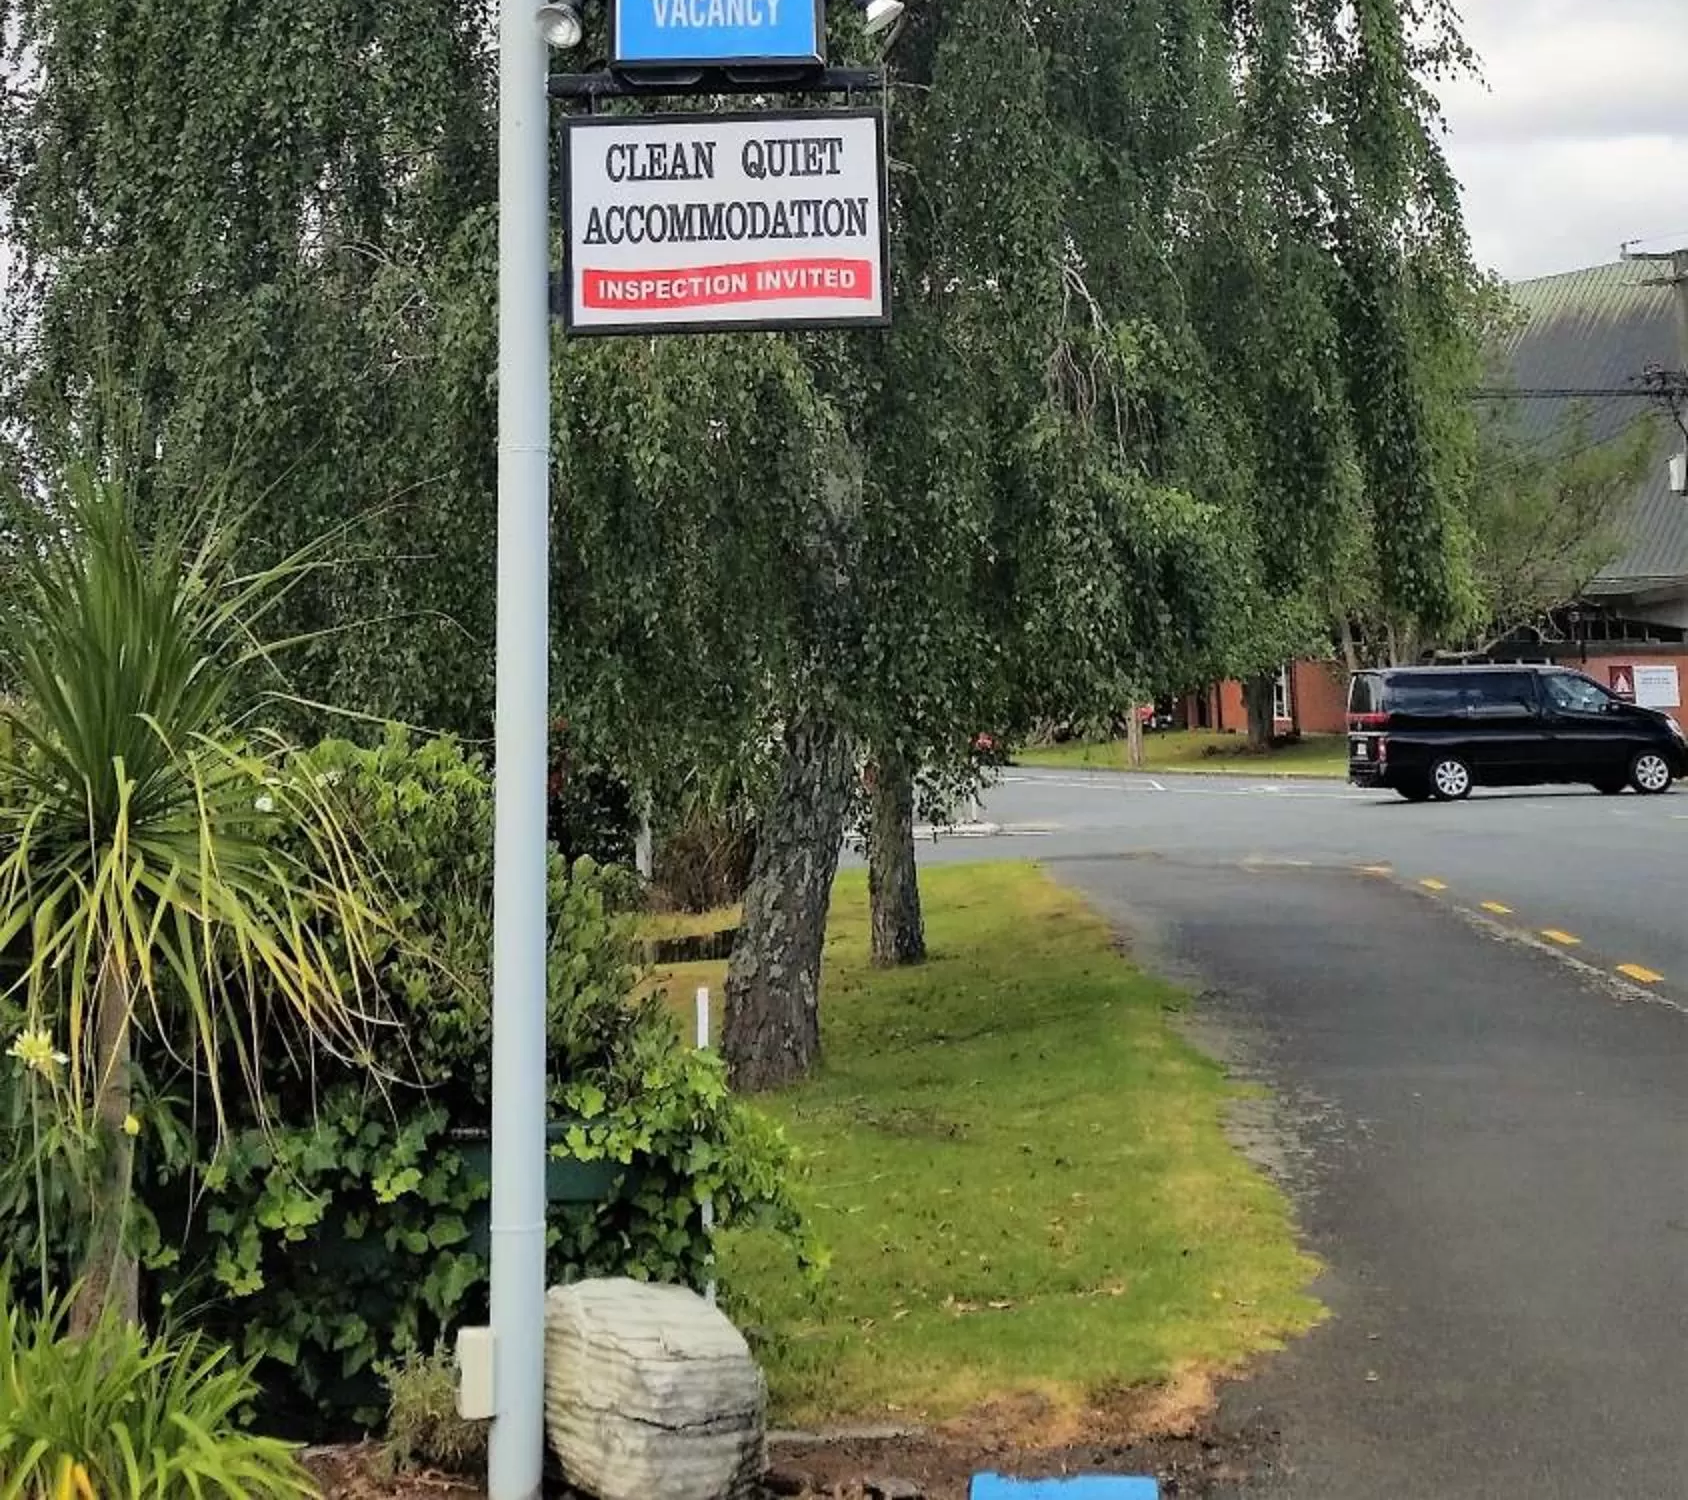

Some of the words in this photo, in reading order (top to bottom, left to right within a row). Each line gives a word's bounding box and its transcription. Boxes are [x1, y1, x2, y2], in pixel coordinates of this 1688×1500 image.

[605, 141, 716, 182] CLEAN
[741, 137, 843, 180] QUIET
[583, 197, 868, 245] ACCOMMODATION
[599, 273, 748, 301] INSPECTION
[756, 266, 855, 290] INVITED
